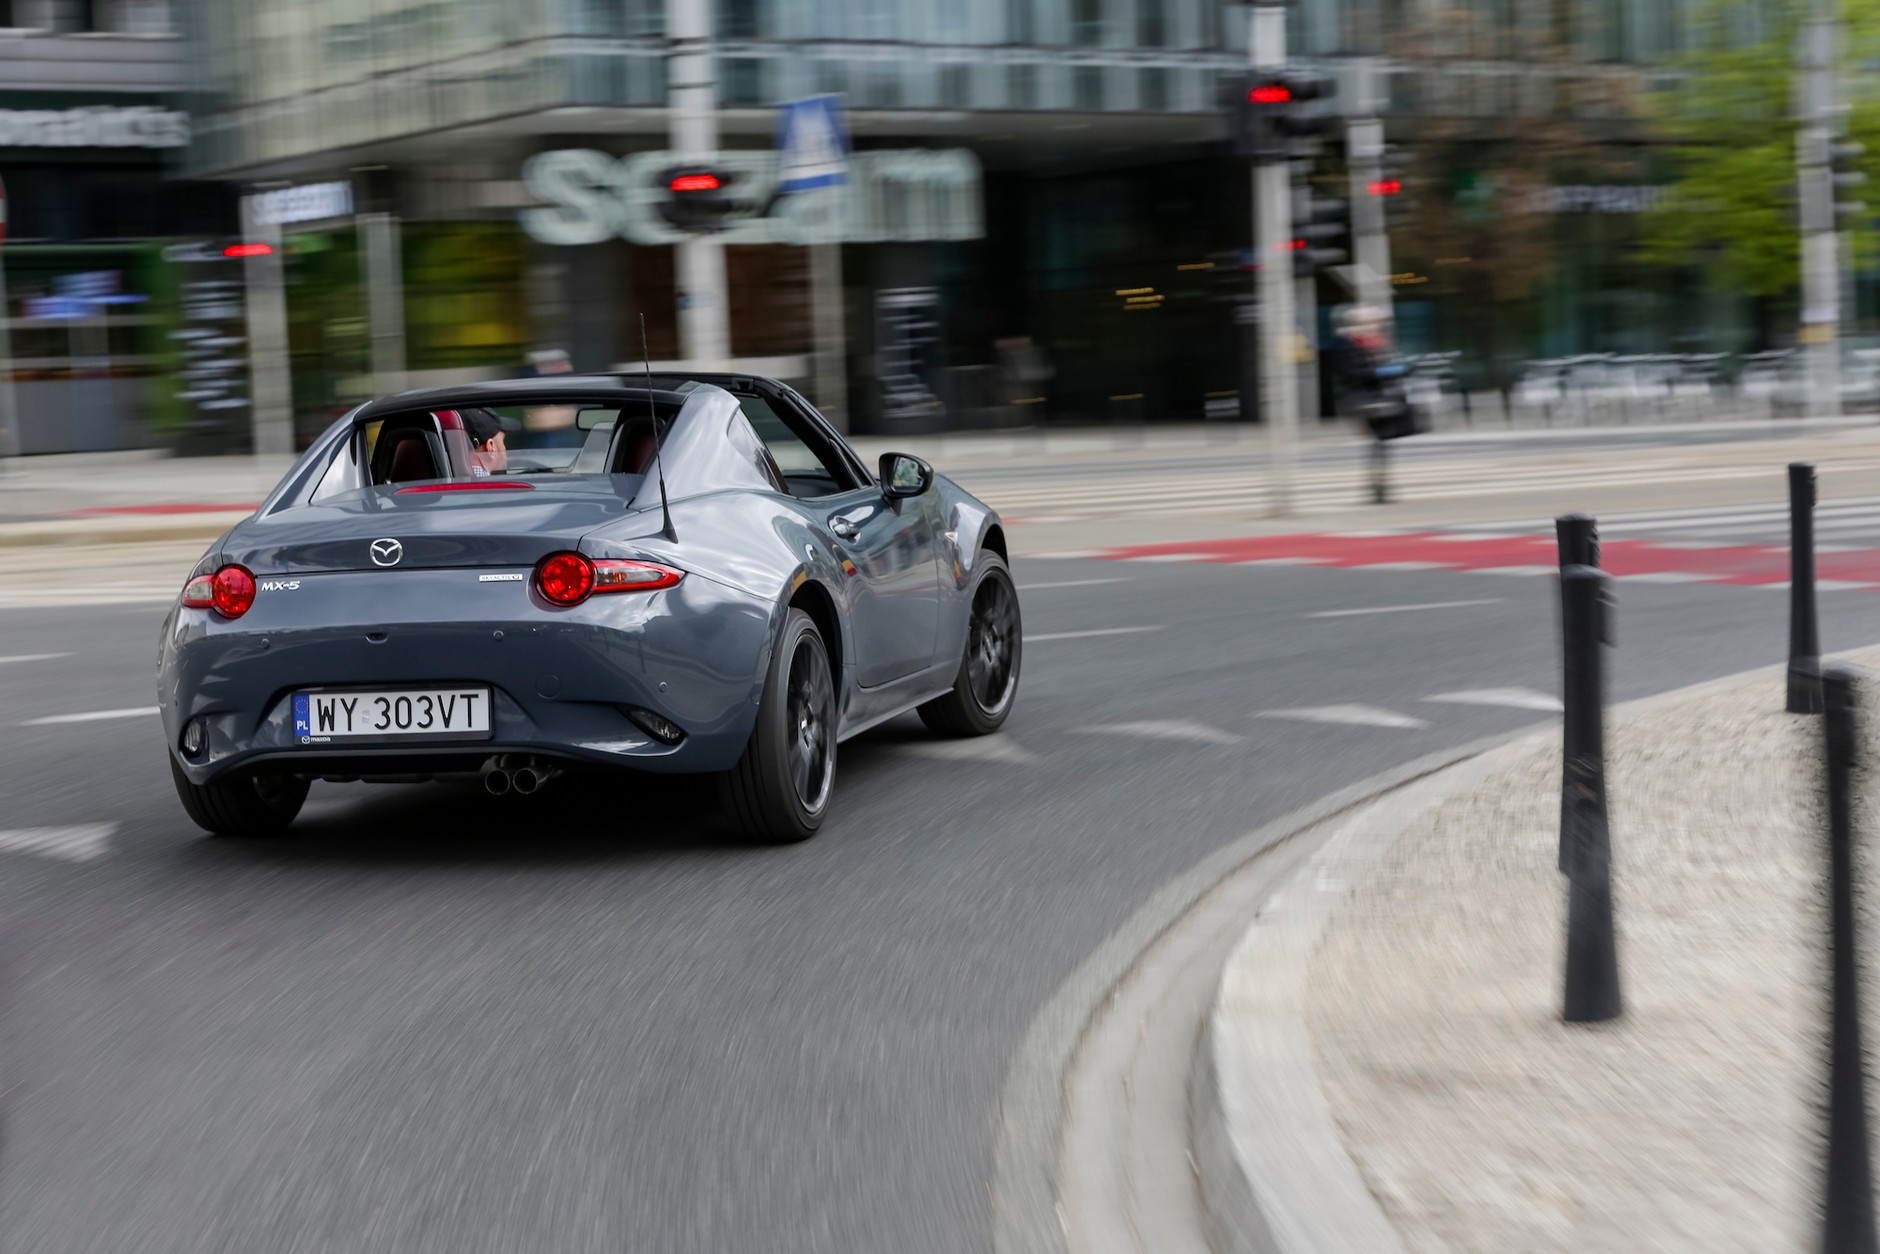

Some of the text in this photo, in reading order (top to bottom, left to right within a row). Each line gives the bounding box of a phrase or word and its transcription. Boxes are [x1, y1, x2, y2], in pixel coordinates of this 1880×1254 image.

[261, 580, 300, 591] MX-5
[317, 693, 479, 732] WY 303VT
[296, 720, 309, 731] PL
